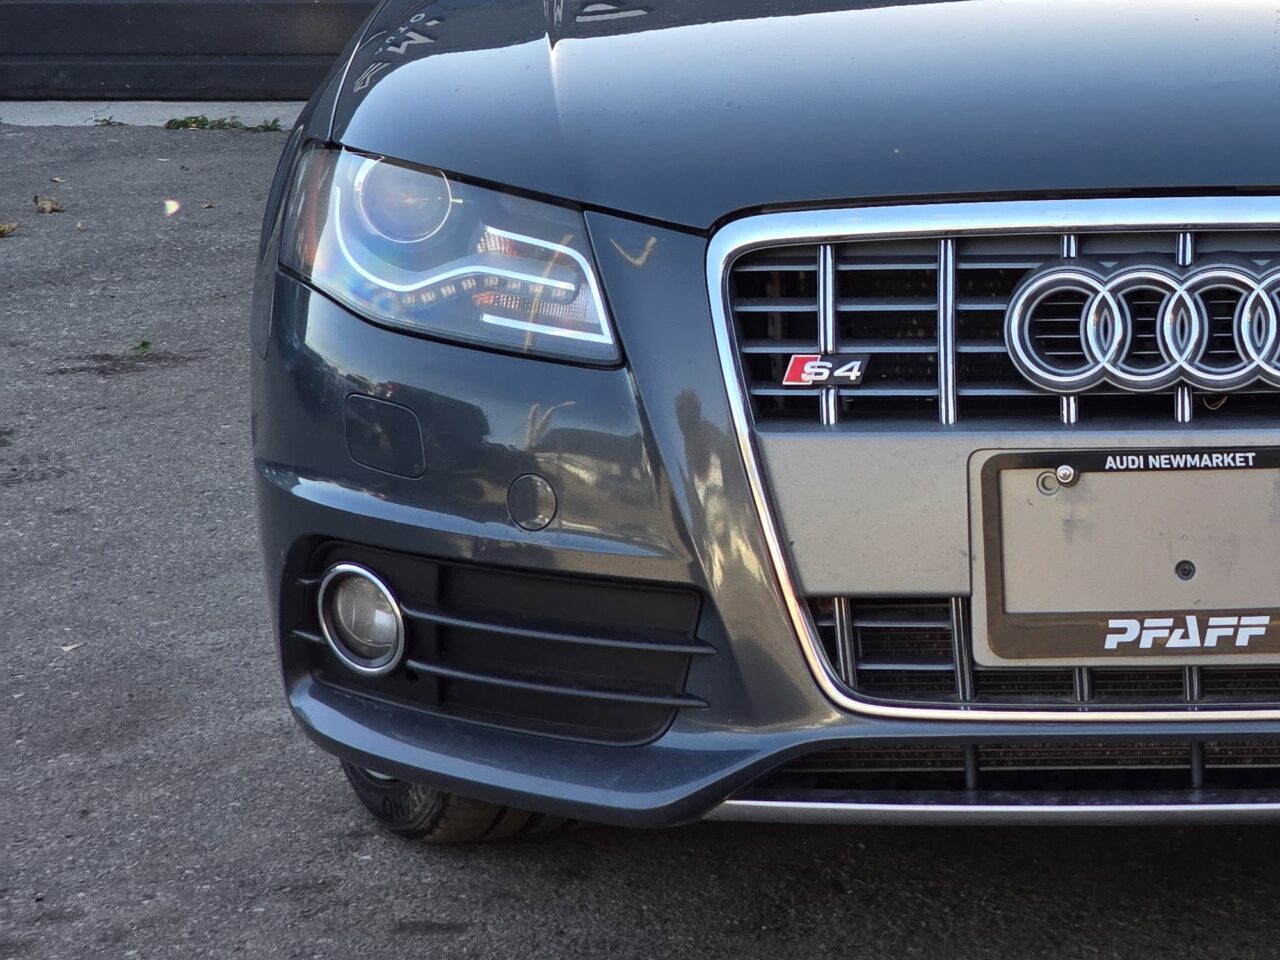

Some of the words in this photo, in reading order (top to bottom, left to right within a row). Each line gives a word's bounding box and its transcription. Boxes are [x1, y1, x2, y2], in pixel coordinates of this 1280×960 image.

[800, 360, 862, 382] S4
[1104, 454, 1144, 470] AUDI
[1148, 452, 1256, 468] NEWMARKET
[1103, 615, 1271, 649] PFAFF
